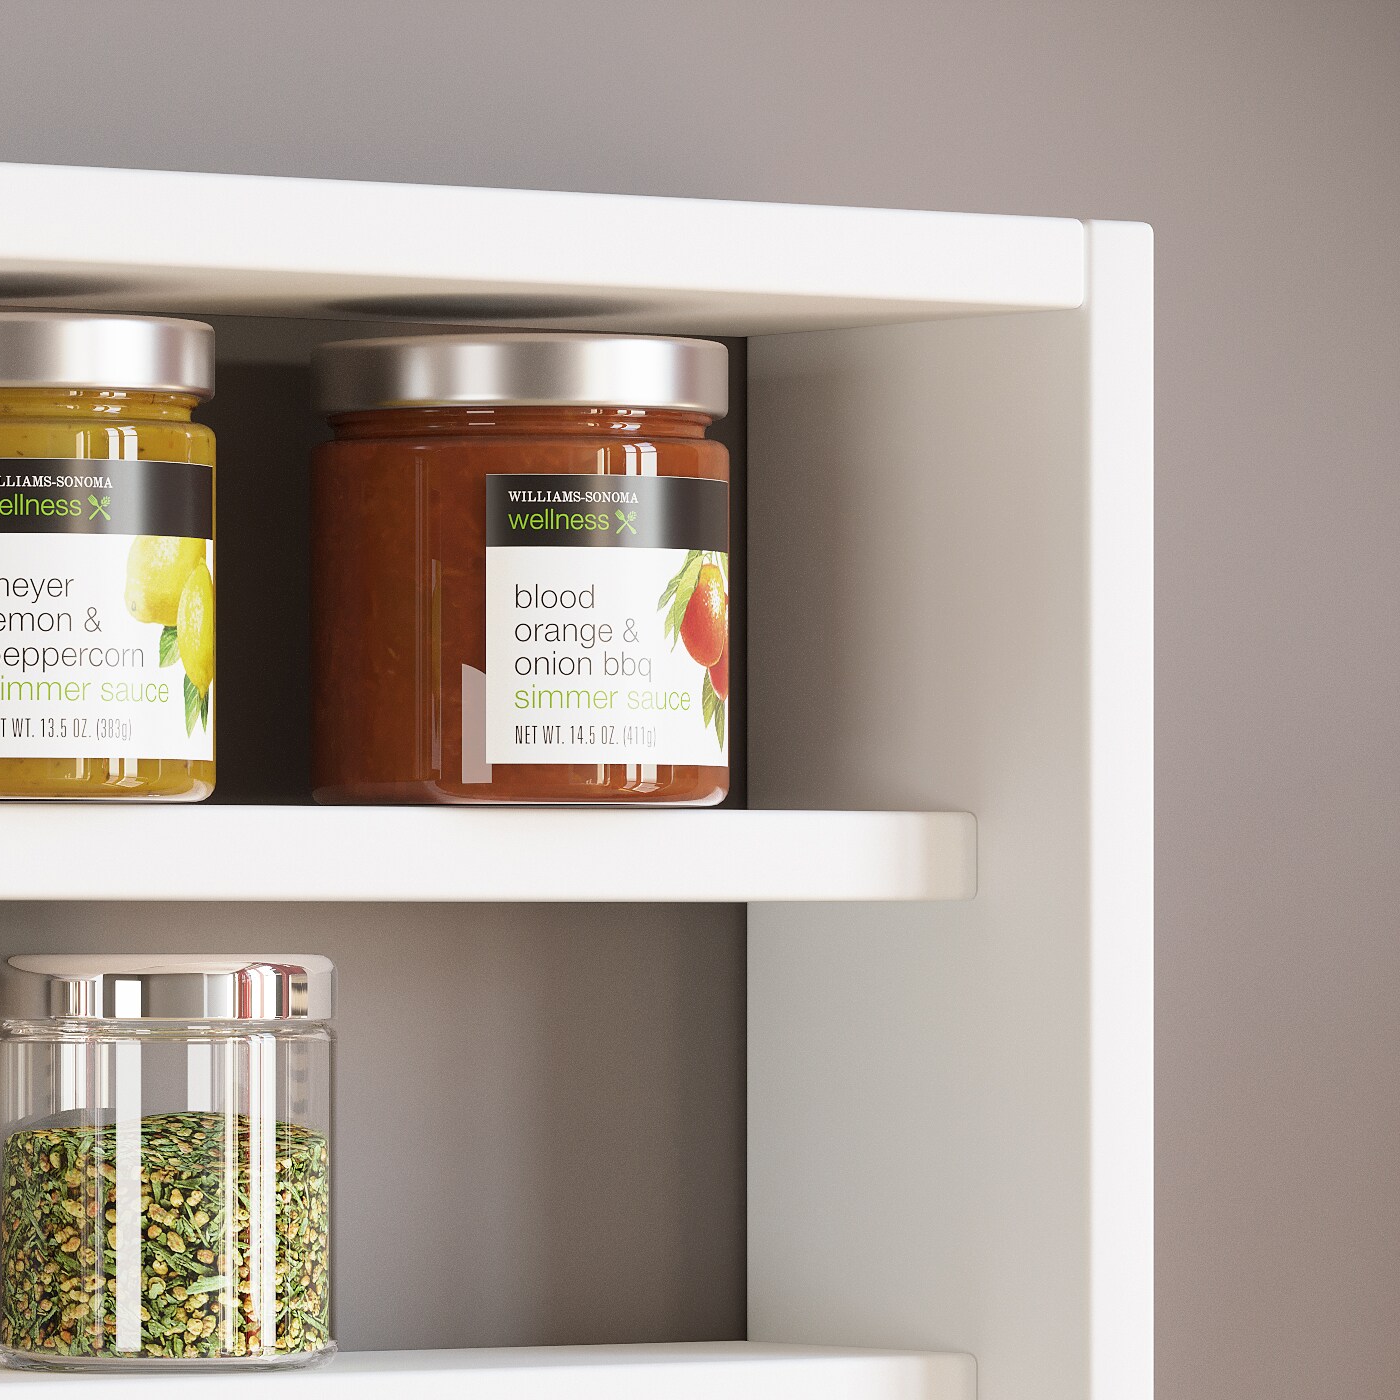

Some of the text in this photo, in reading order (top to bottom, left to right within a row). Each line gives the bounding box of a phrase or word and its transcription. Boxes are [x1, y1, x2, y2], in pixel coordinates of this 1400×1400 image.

[508, 490, 639, 504] WILLIAMS-SONOMA
[508, 509, 610, 530] wellness
[515, 584, 595, 609] blood
[84, 607, 102, 632] &
[515, 618, 639, 649] orange &
[515, 651, 652, 682] onion bbq
[100, 682, 169, 702] sauce
[514, 684, 691, 710] simmer sauce
[11, 718, 34, 738] WT.
[40, 718, 67, 738] 13.5
[73, 718, 91, 739] OZ.
[96, 718, 132, 741] (383g)
[515, 725, 656, 747] NET WT. 14.5 OZ. (411g)
